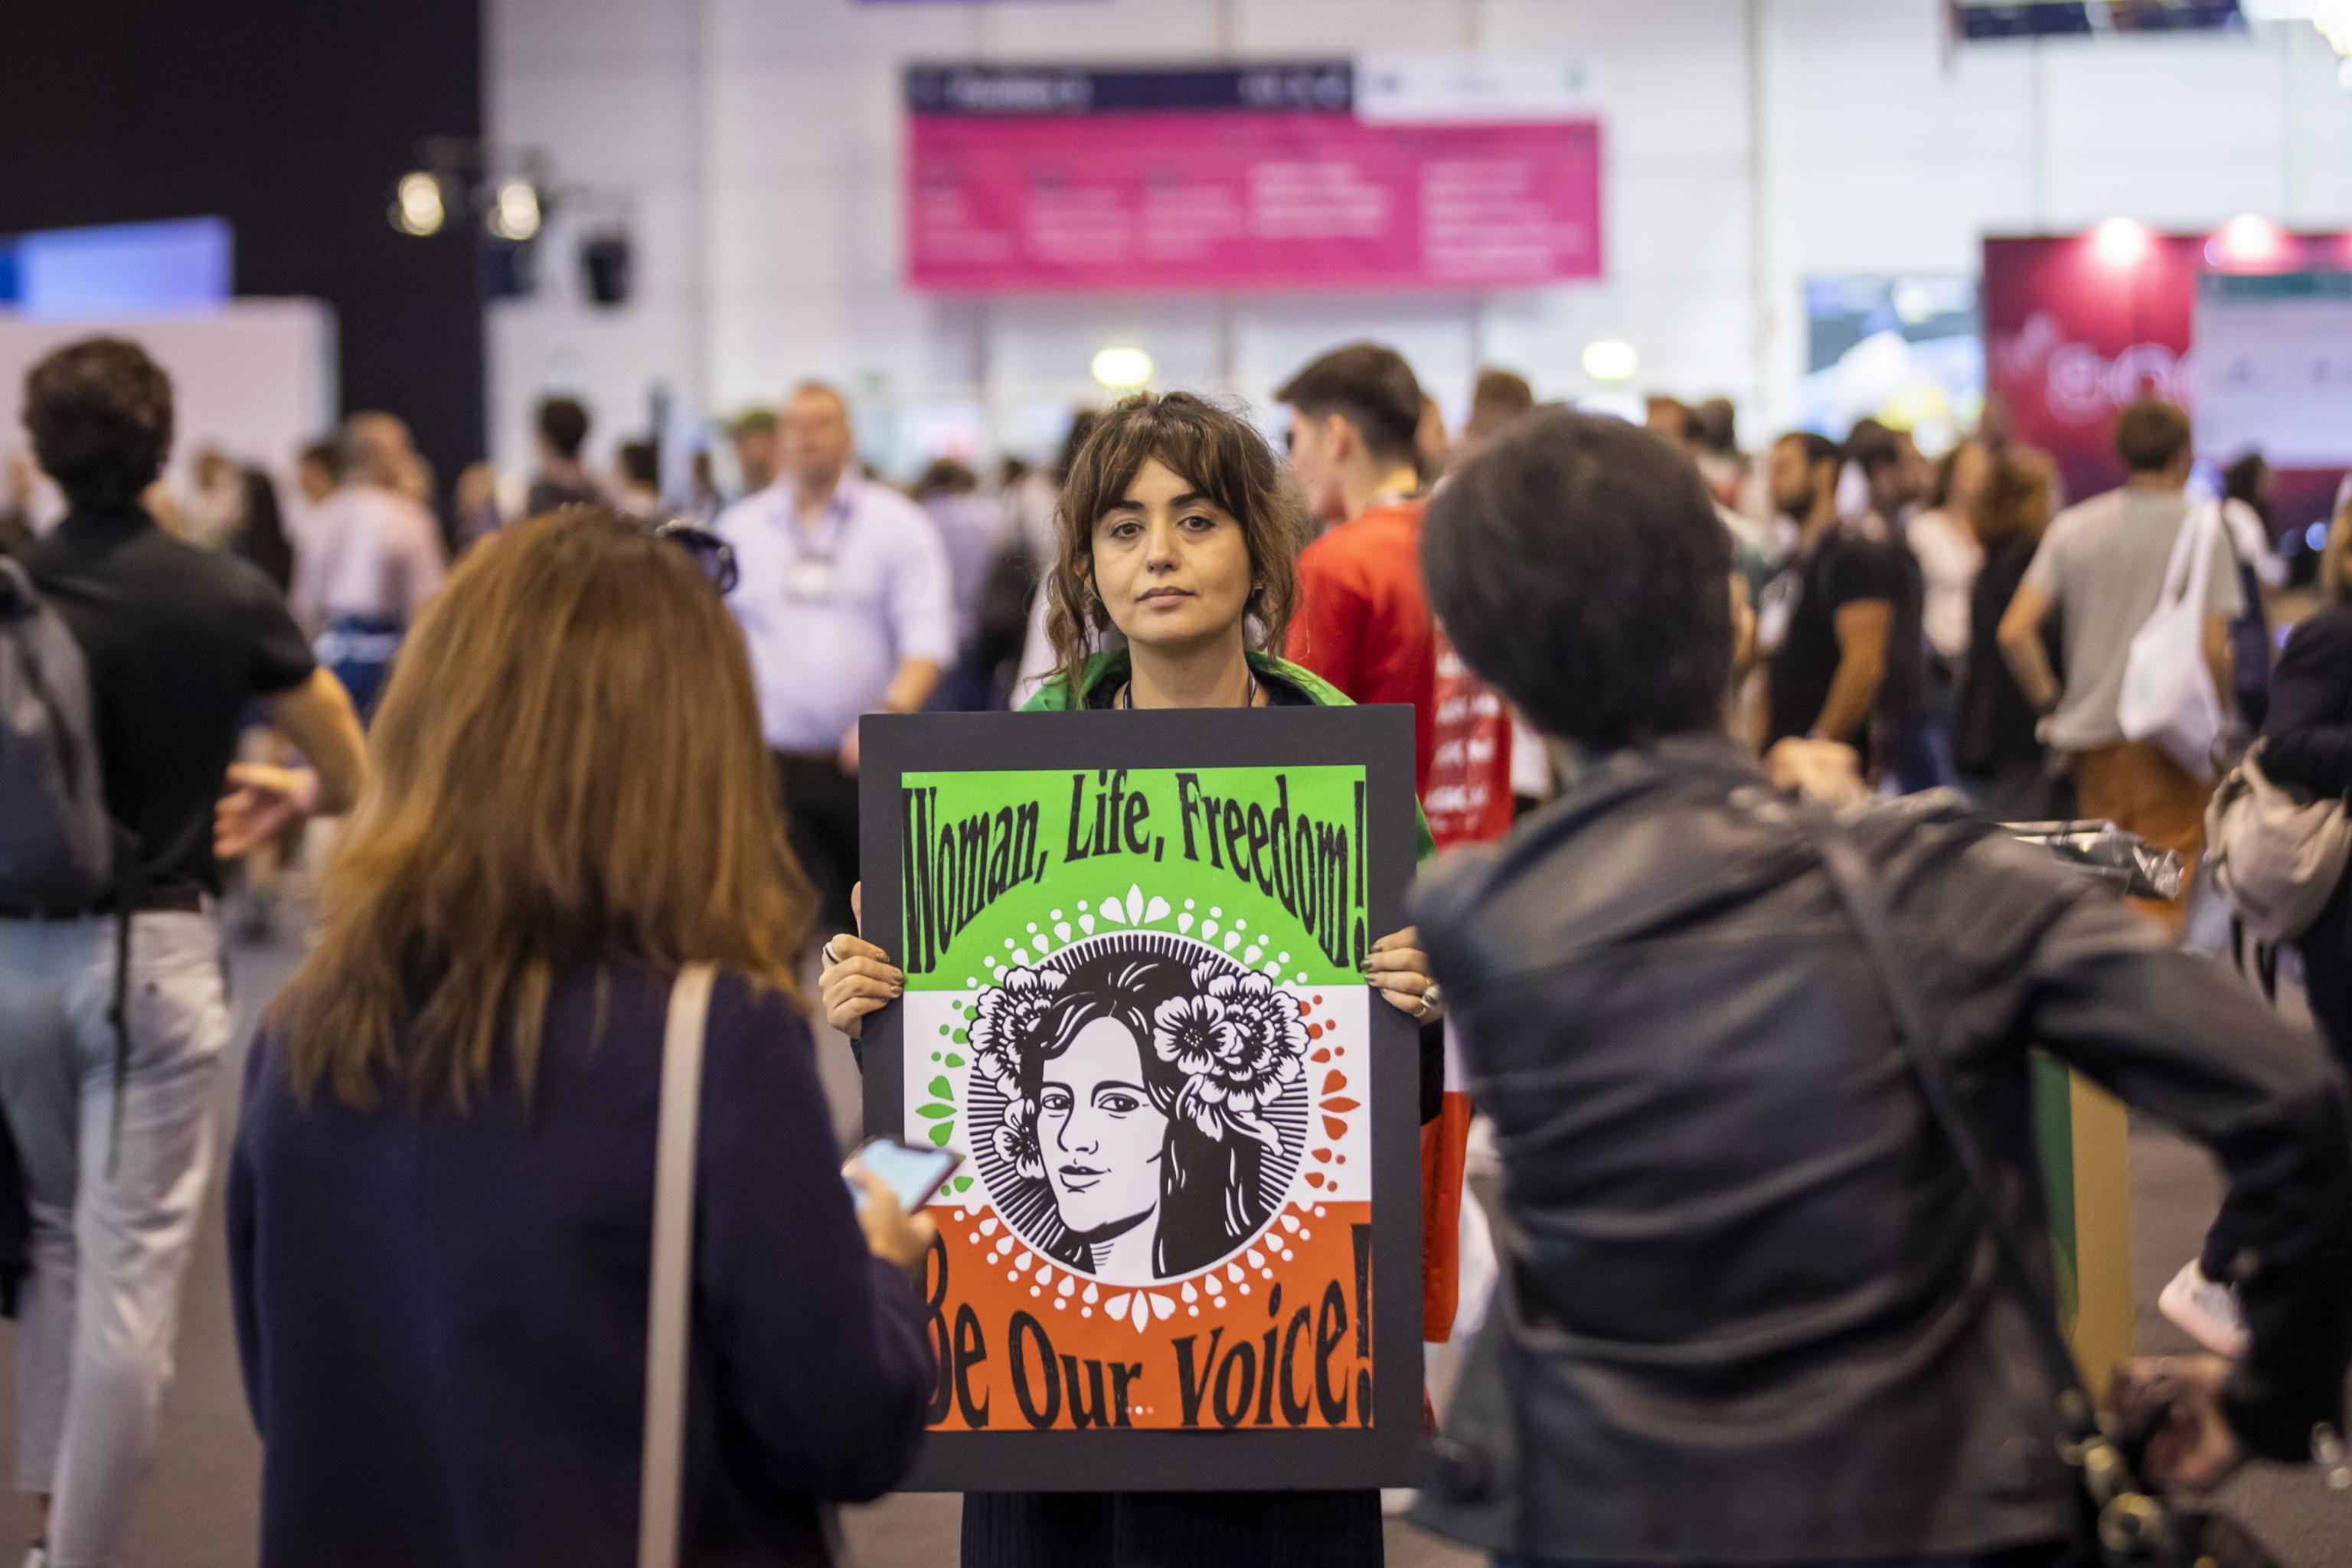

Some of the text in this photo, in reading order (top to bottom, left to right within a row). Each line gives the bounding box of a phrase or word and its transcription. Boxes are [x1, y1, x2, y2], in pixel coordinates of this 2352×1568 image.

[902, 768, 1367, 974] Woman, Life, Freedom!
[923, 1223, 1373, 1429] Be Our Voice!
